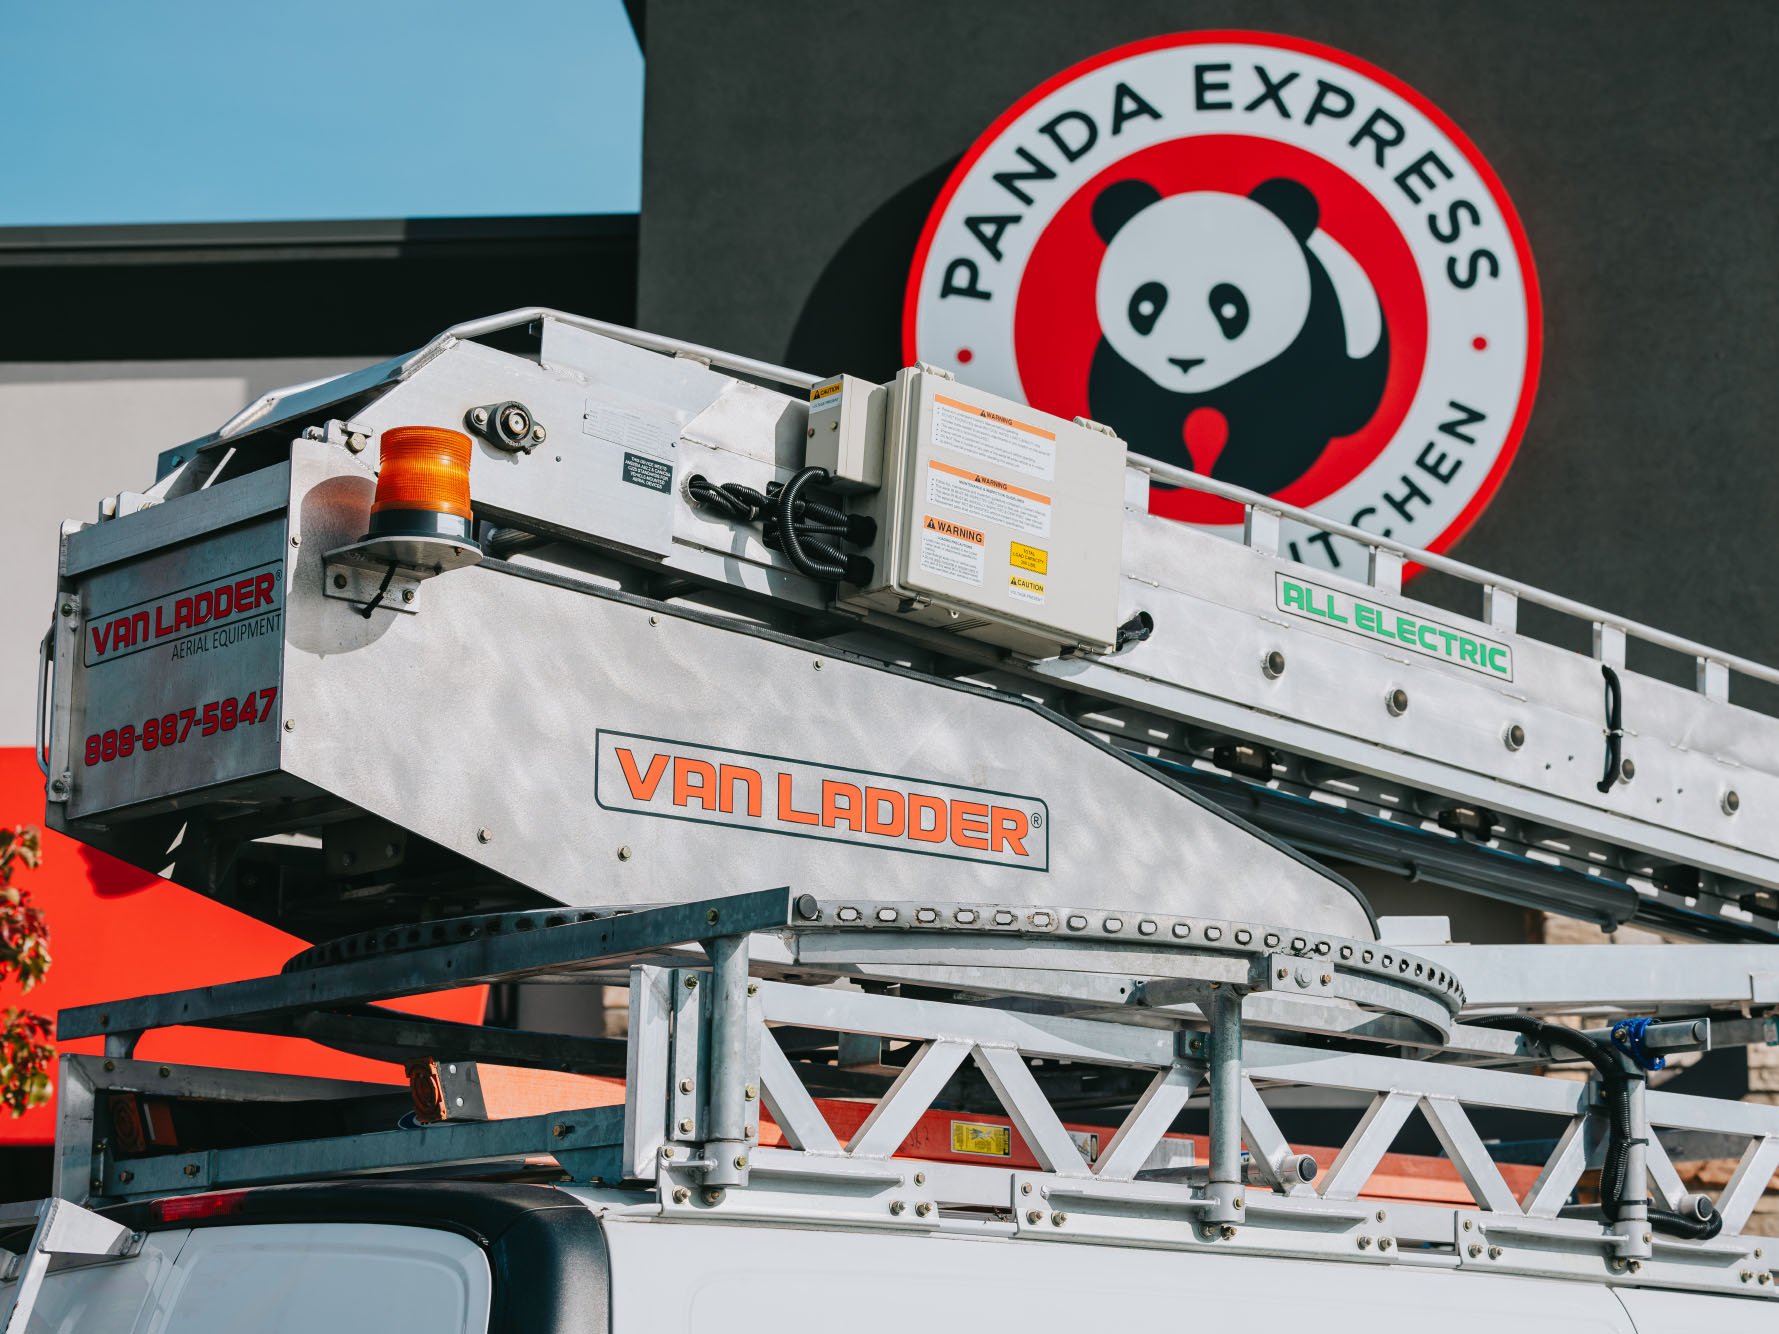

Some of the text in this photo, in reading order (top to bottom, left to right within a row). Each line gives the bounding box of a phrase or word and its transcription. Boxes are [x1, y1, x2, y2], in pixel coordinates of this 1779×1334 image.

[939, 62, 1500, 302] PANDA EXPRESS
[986, 412, 1013, 426] WARNING
[980, 476, 1008, 491] WARNING
[1287, 400, 1488, 569] ITCHEN
[937, 520, 983, 543] WARNING
[1017, 579, 1044, 592] CAUTION
[91, 611, 150, 656] VAN
[171, 613, 282, 662] AERIAL EQUIPMENT
[1283, 581, 1508, 674] ALL ELECTRIC
[84, 686, 278, 767] 888-887-5847
[615, 747, 763, 818] VAN
